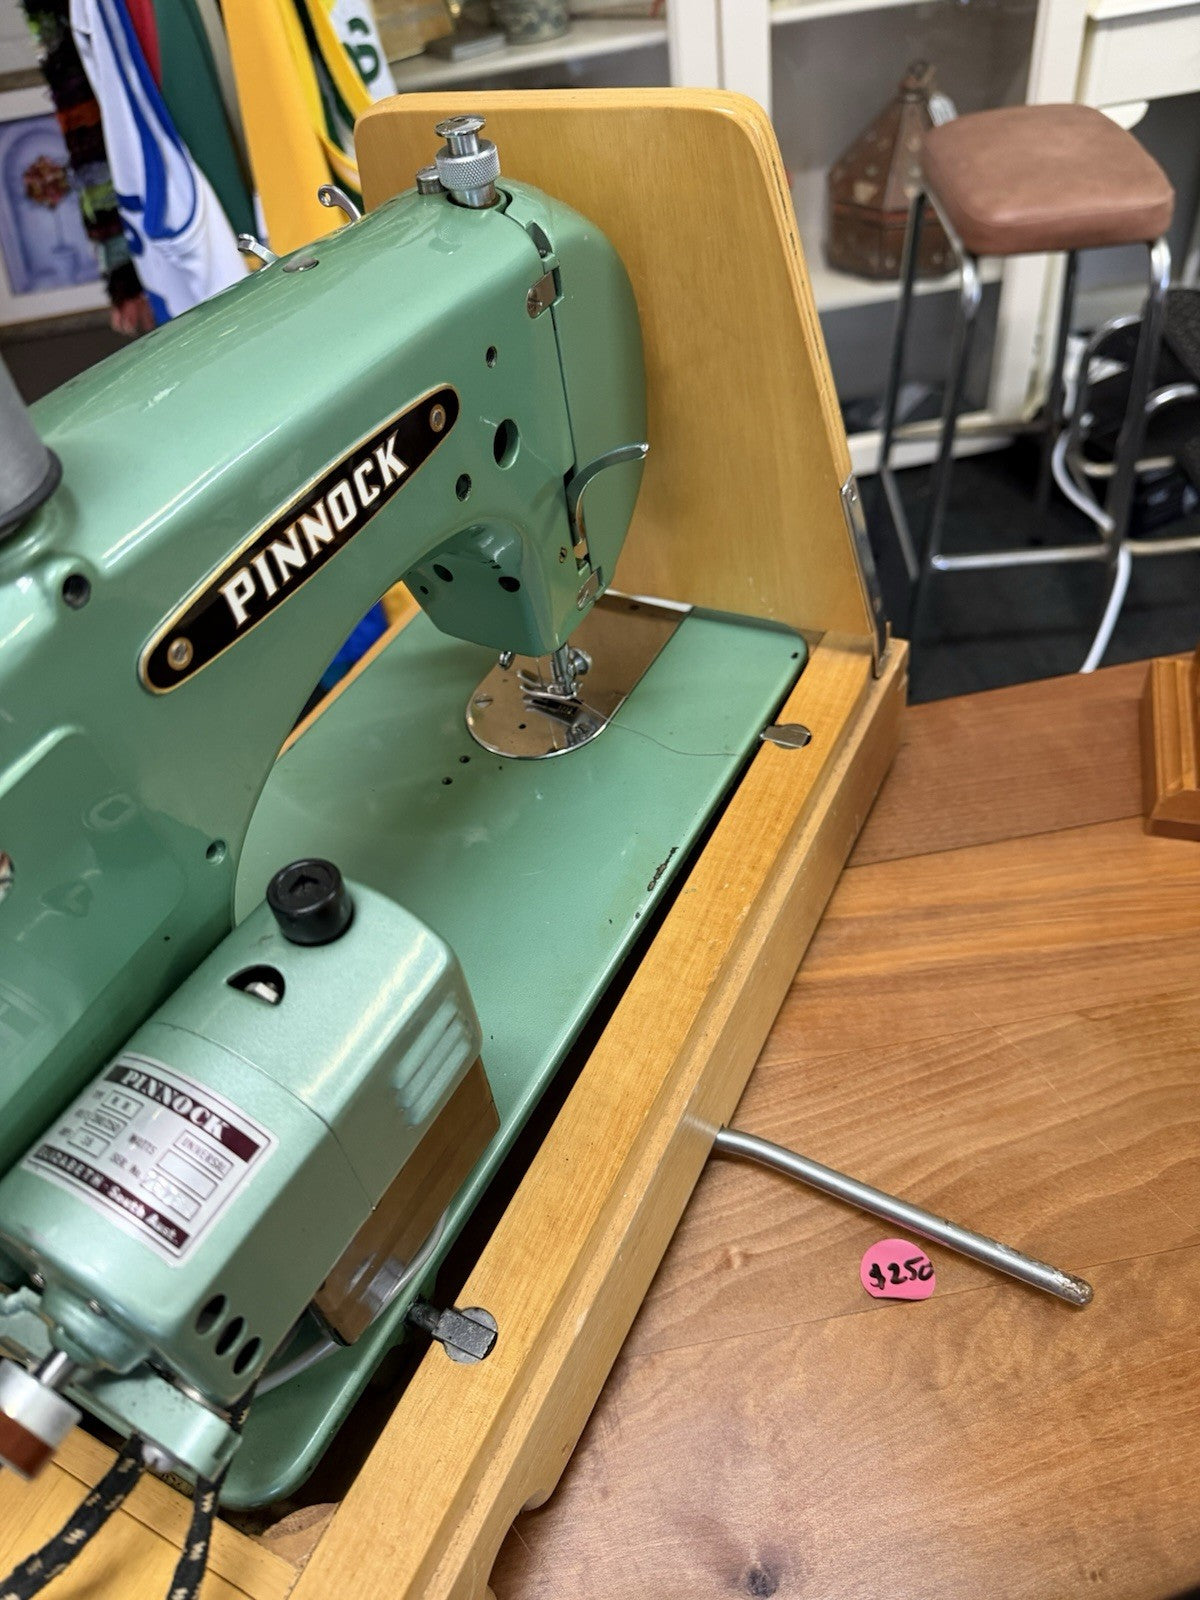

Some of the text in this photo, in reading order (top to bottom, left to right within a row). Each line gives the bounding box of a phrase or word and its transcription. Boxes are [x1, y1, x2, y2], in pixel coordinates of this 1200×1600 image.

[218, 430, 408, 628] PINNOCK
[119, 1068, 230, 1142] PINNOCK
[869, 1256, 934, 1290] $250
